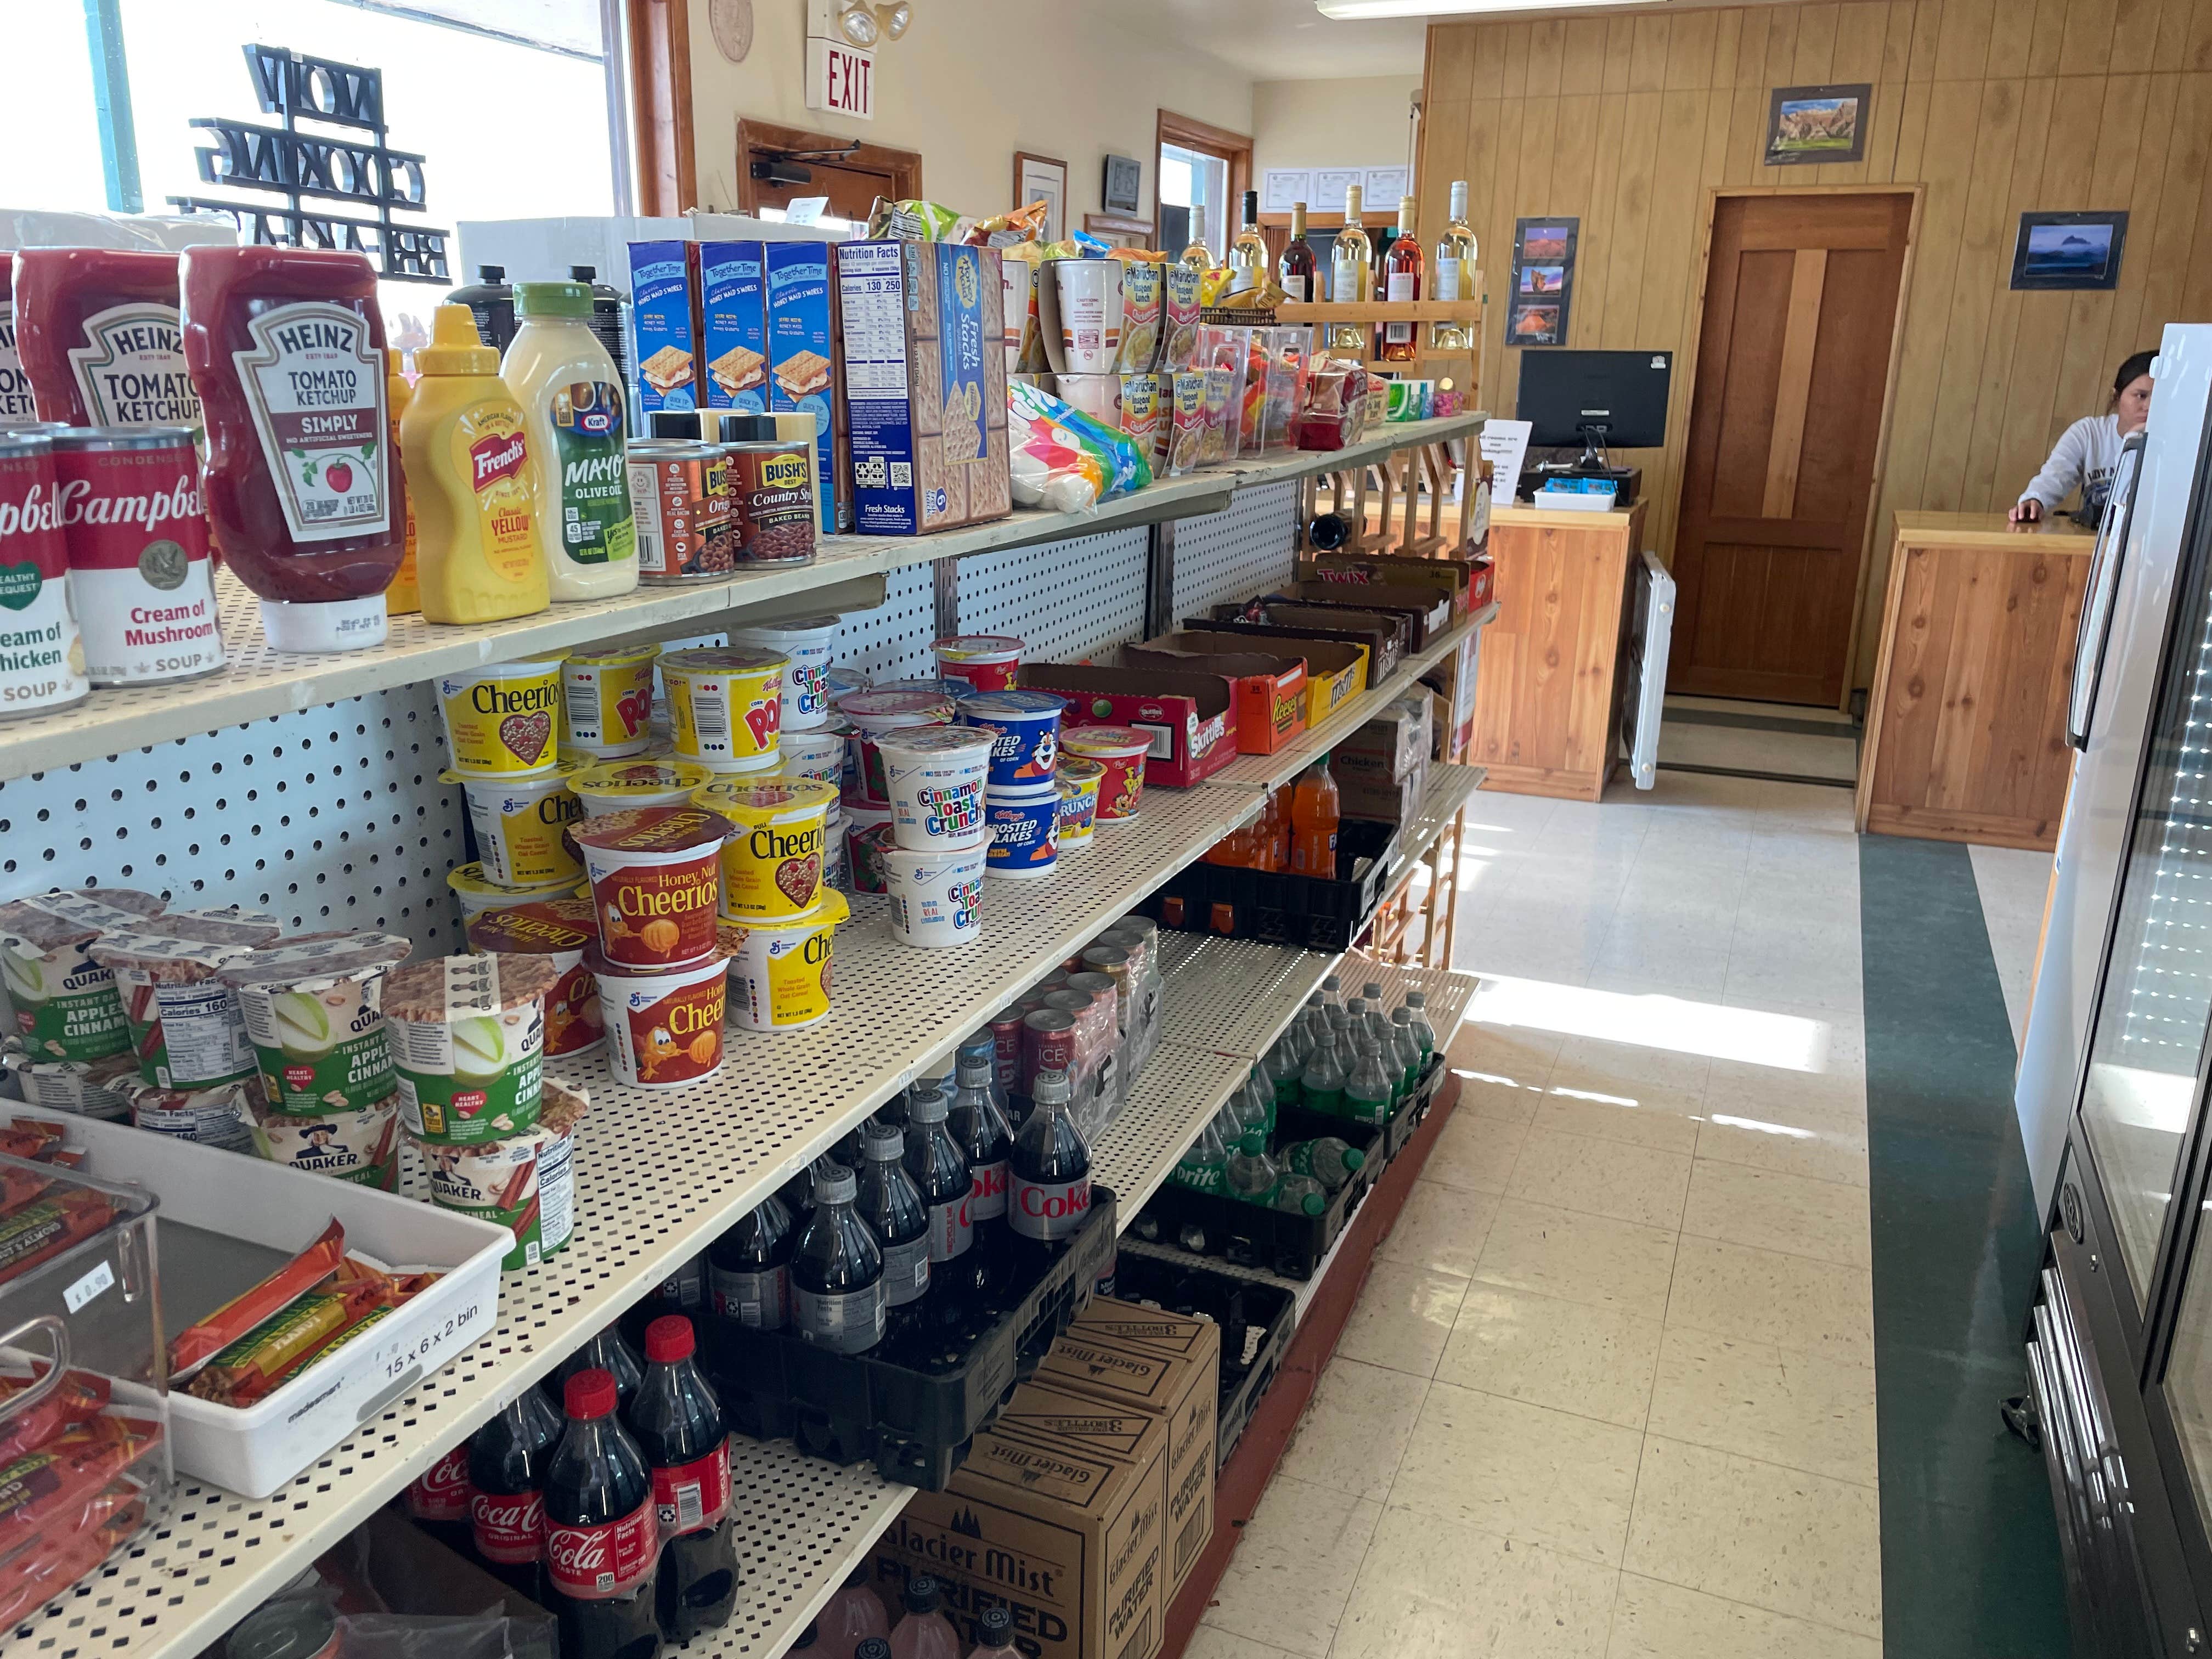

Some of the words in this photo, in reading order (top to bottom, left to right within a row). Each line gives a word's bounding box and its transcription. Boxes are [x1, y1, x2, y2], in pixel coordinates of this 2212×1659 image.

[829, 50, 871, 114] EXIT
[839, 247, 874, 259] Nutrition
[877, 246, 899, 258] Facts
[638, 264, 667, 279] Together
[668, 263, 682, 273] Time
[775, 267, 805, 281] Together
[807, 266, 822, 276] Time
[943, 262, 949, 275] NO
[1131, 267, 1159, 281] Maruchan
[1175, 270, 1199, 284] Maruchan
[867, 281, 881, 291] 130
[885, 280, 900, 290] 250
[958, 266, 968, 299] Maid
[961, 257, 974, 303] Honey
[1133, 283, 1152, 294] Instant
[664, 284, 683, 295] S'MORES
[803, 287, 823, 298] S'MORES
[1136, 293, 1150, 302] Lunch
[1177, 285, 1193, 295] Instant
[1178, 295, 1192, 304] Lunch
[112, 326, 184, 356] HEINZ
[277, 324, 353, 354] HEINZ
[961, 312, 970, 371] Stacks
[969, 320, 980, 368] Fresh
[287, 369, 357, 390] TOMATO
[1129, 380, 1156, 393] Maruchan
[1180, 379, 1204, 390] Maruchan
[297, 389, 357, 406] KETCHUP
[1132, 394, 1150, 404] Instant
[1182, 392, 1198, 401] Instant
[1184, 401, 1197, 410] Lunch
[116, 399, 201, 422] KETCHUP
[1134, 404, 1148, 414] Lunch
[301, 414, 358, 433] SIMPLY
[477, 412, 500, 427] AMERICAN
[588, 416, 605, 427] Kraft
[474, 438, 525, 479] French's
[565, 454, 624, 487] MAYO
[764, 461, 807, 482] BUSH'S
[575, 487, 608, 499] OLIVE
[609, 484, 622, 495] OIL
[753, 487, 799, 507] Country
[937, 494, 946, 505] 6
[498, 506, 522, 517] Classic
[865, 504, 882, 514] Fresh
[884, 504, 905, 514] Stacks
[491, 515, 530, 537] YELLOW
[769, 513, 793, 524] BAKED
[569, 524, 578, 533] 45
[497, 533, 528, 545] MUSTARD
[131, 606, 190, 624] Cream
[192, 599, 206, 617] of
[46, 622, 62, 640] of
[125, 622, 213, 647] Mushroom
[0, 648, 62, 672] hicken
[155, 653, 202, 672] SOUP
[4, 681, 58, 702] SOUP
[1272, 693, 1297, 725] Reese's
[1190, 715, 1225, 759] Skittles
[1340, 755, 1385, 768] Chicken
[582, 777, 701, 788] Cheerios
[706, 783, 823, 793] Cheerios
[918, 777, 984, 806] Cinnamon
[898, 808, 910, 817] REAL
[933, 793, 975, 817] Toast
[1061, 794, 1096, 817] RUNCH
[926, 804, 983, 836] Crunch
[995, 810, 1025, 821] Kellogg's
[994, 830, 1033, 843] LAKES
[658, 872, 698, 888] Honey
[701, 863, 716, 879] Nut
[618, 877, 718, 916] Cheerios
[923, 907, 938, 916] REAL
[488, 913, 588, 947] Cheerios
[57, 996, 100, 1009] INSTANT
[792, 990, 808, 998] Cereal
[160, 1008, 200, 1017] Calories
[205, 1000, 227, 1012] 160
[343, 1036, 379, 1054] INSTANT
[1037, 1047, 1065, 1063] ICE
[513, 1059, 538, 1075] INSTANT
[454, 1099, 484, 1108] HEALTHY
[538, 1139, 566, 1159] Nutrition
[289, 1153, 358, 1171] QUAKER
[539, 1167, 567, 1186] Calories
[1177, 1167, 1220, 1187] prite
[431, 1180, 482, 1200] QUAKER
[1020, 1186, 1092, 1218] Coke
[946, 1205, 953, 1221] ME
[25, 1221, 61, 1247] ALMOND
[273, 1316, 323, 1351] PEANUT
[386, 1357, 404, 1378] 15
[407, 1351, 416, 1364] x
[420, 1338, 429, 1355] 6
[432, 1332, 441, 1345] x
[444, 1319, 454, 1337] 2
[458, 1304, 478, 1327] bin
[1058, 1342, 1095, 1362] Mist
[1098, 1352, 1152, 1376] Glacier
[1107, 1419, 1122, 1432] 3
[1171, 1424, 1194, 1470] Glacier
[1195, 1399, 1212, 1436] Mist
[990, 1444, 1029, 1466] Mist
[1032, 1456, 1091, 1483] Glacier
[1170, 1440, 1212, 1518] PURIFIED
[1174, 1465, 1208, 1523] WATER
[616, 1514, 644, 1533] Nutrition
[487, 1532, 534, 1542] ORIGINAL
[617, 1528, 635, 1541] Facts
[1109, 1540, 1138, 1585] Glacier
[1139, 1502, 1159, 1543] Mist
[549, 1529, 613, 1570] Cola
[556, 1564, 583, 1576] TASTE
[598, 1575, 613, 1583] 200
[985, 1547, 1054, 1598] Mist
[1109, 1545, 1159, 1635] PURIFIED
[1115, 1572, 1154, 1641] WATER
